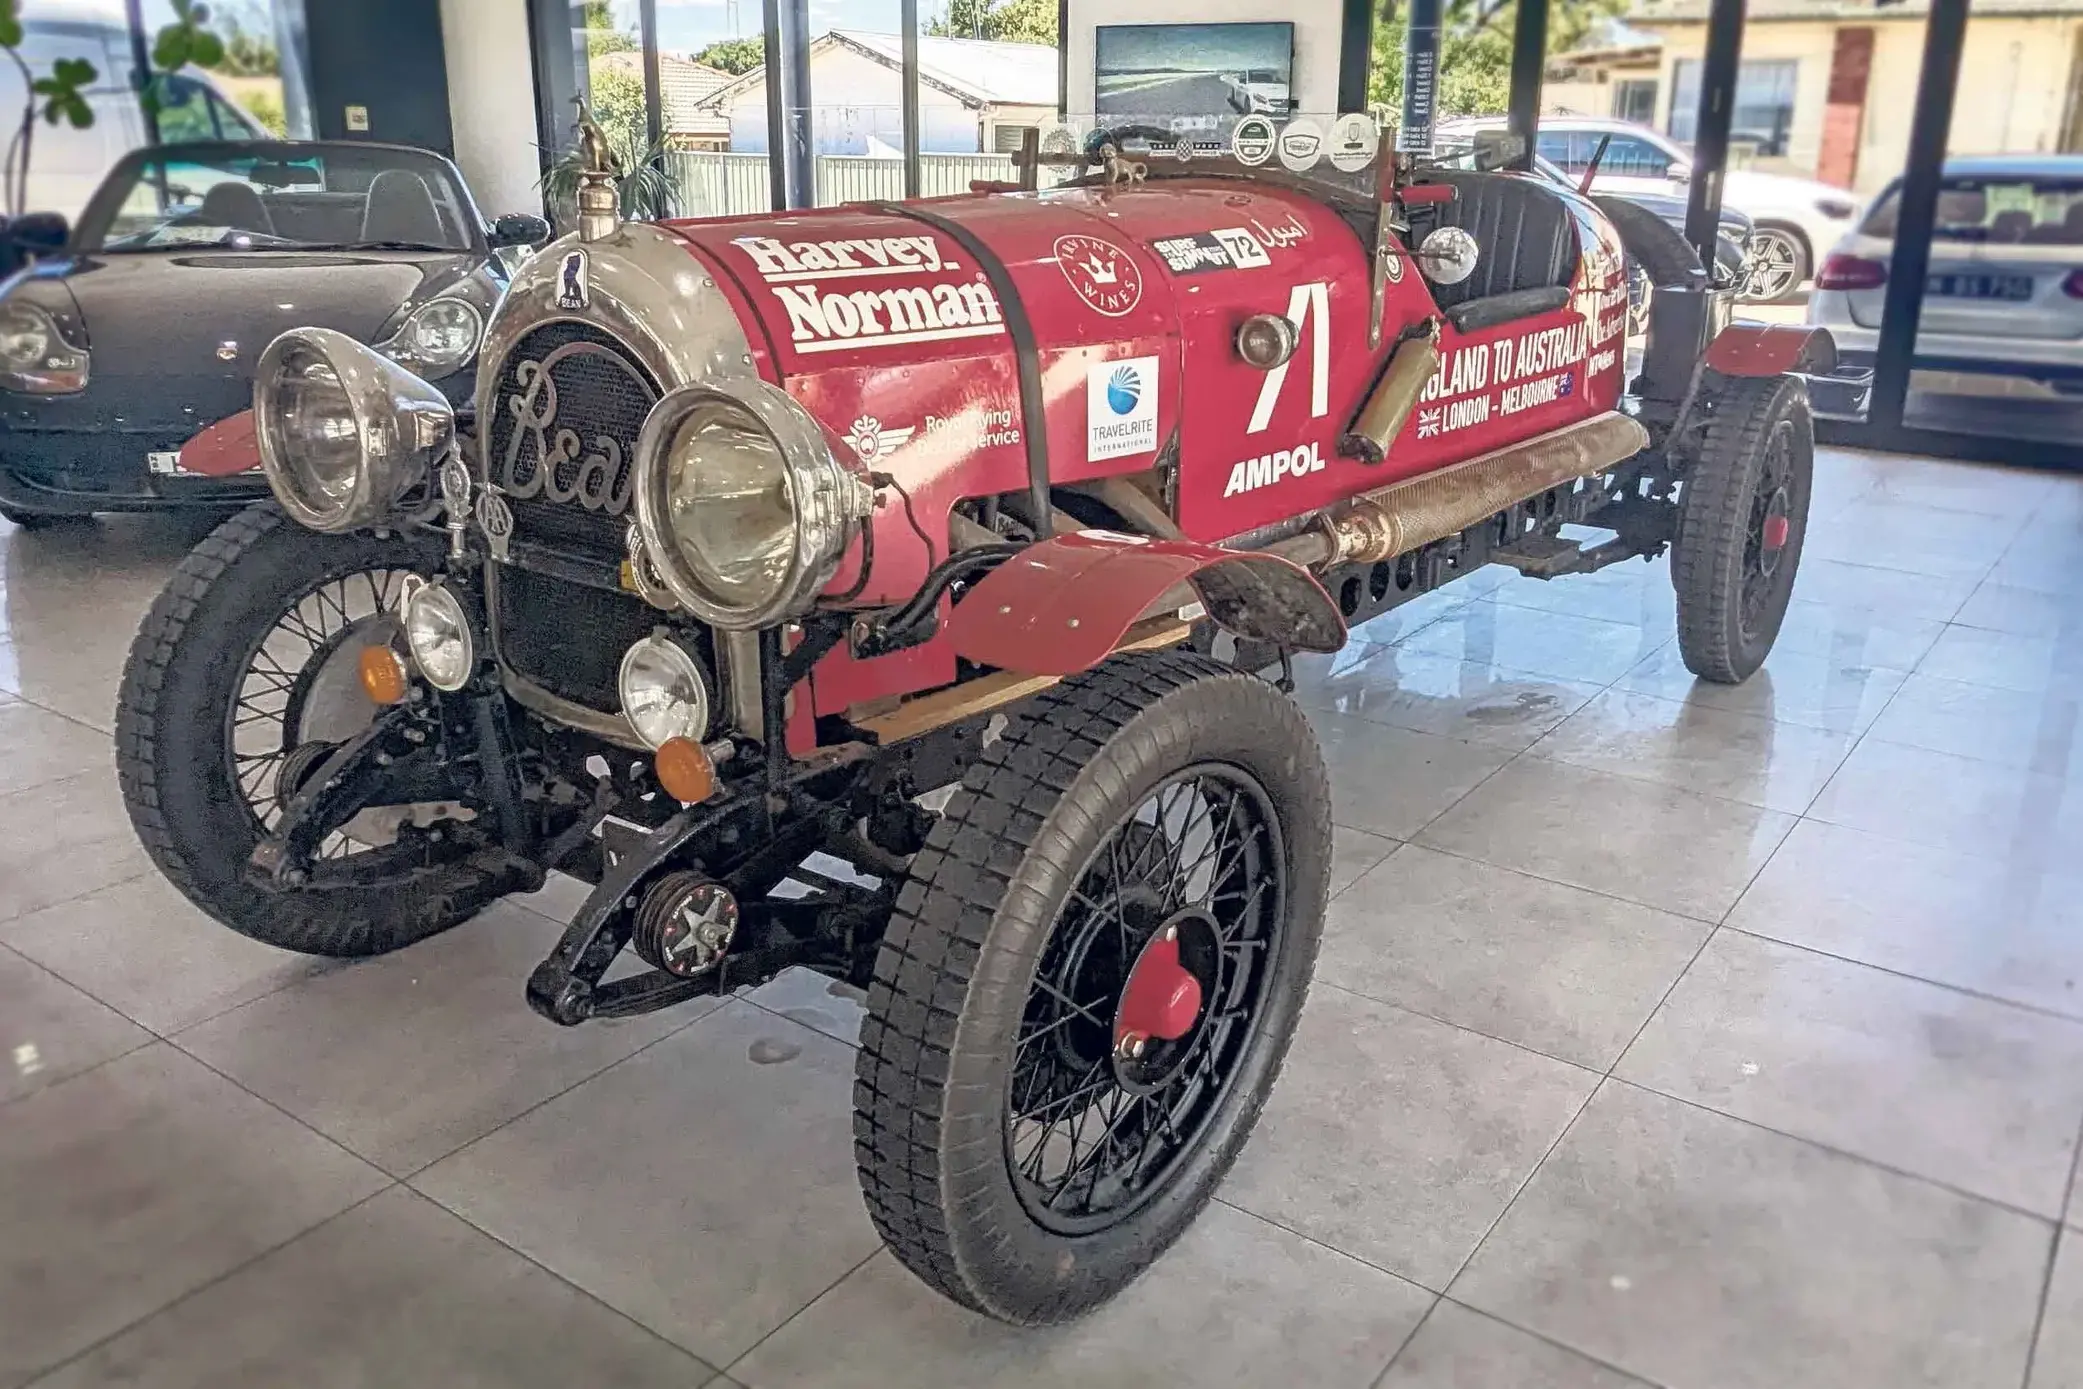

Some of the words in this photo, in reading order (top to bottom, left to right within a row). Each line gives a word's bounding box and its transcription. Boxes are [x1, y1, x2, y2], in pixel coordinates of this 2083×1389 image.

[729, 235, 942, 273] Harvey
[1223, 235, 1262, 259] 72
[772, 282, 1002, 340] Norman
[1084, 280, 1137, 310] WINES
[1420, 344, 1489, 403] GLAND
[1493, 338, 1513, 385] TO
[1514, 321, 1586, 380] AUSTRALIA
[1442, 394, 1490, 432] LONDON
[1500, 374, 1559, 417] MELBOURNE
[503, 341, 662, 516] Bea
[1092, 418, 1153, 441] TRAVELRITE
[1094, 437, 1152, 453] INTERNATIONAL
[1223, 441, 1325, 498] AMPOL
